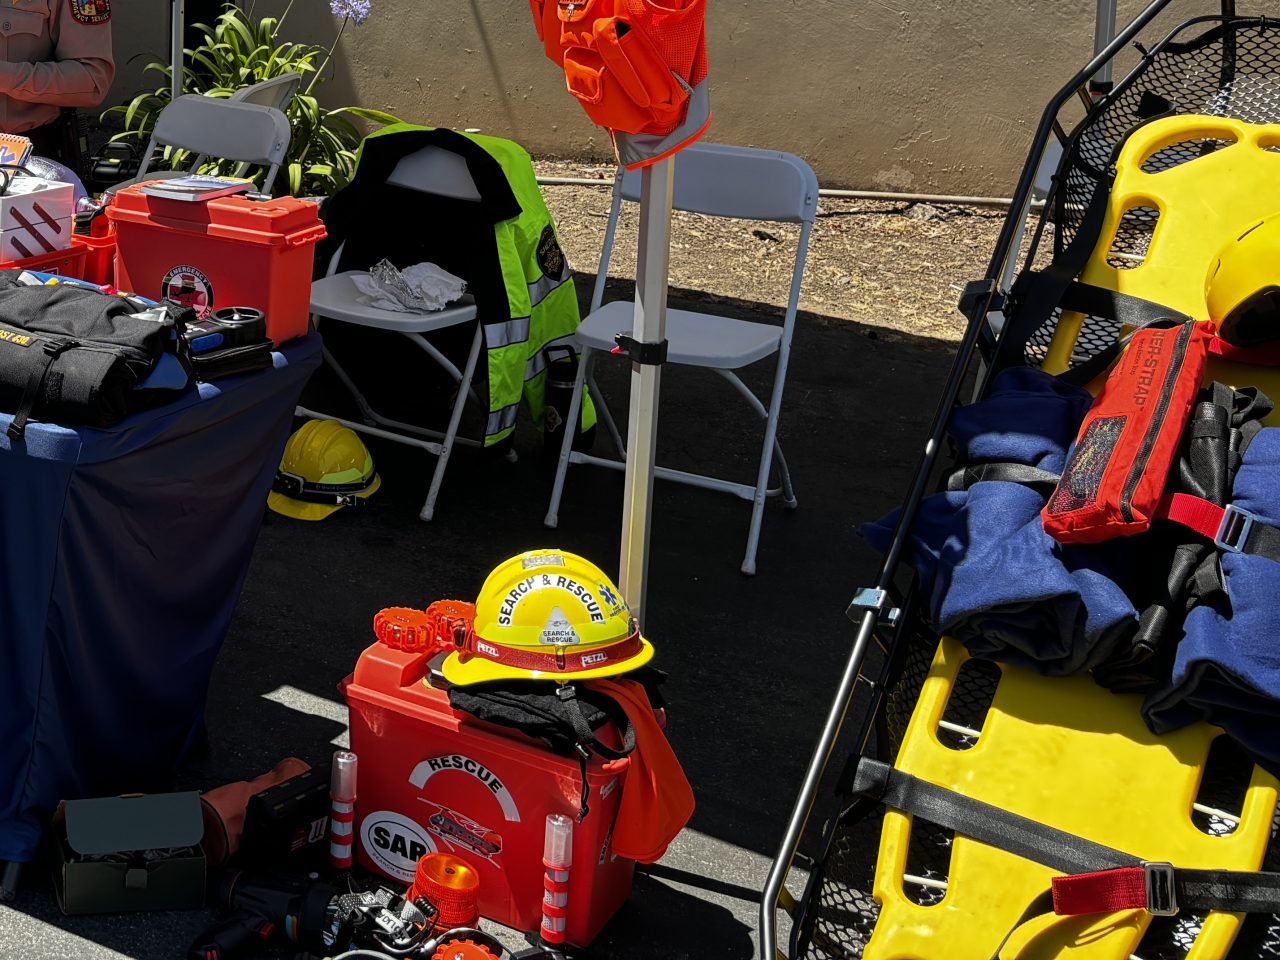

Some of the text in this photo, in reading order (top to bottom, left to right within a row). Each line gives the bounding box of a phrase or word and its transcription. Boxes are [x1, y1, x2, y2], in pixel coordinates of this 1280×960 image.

[170, 266, 210, 287] EMERGENCY
[498, 573, 604, 627] SEARCH & RESCUE
[476, 641, 500, 657] PETZL
[581, 651, 609, 667] PETZL
[427, 755, 503, 794] RESCUE
[373, 826, 428, 863] SAR
[372, 852, 395, 872] SEARCH
